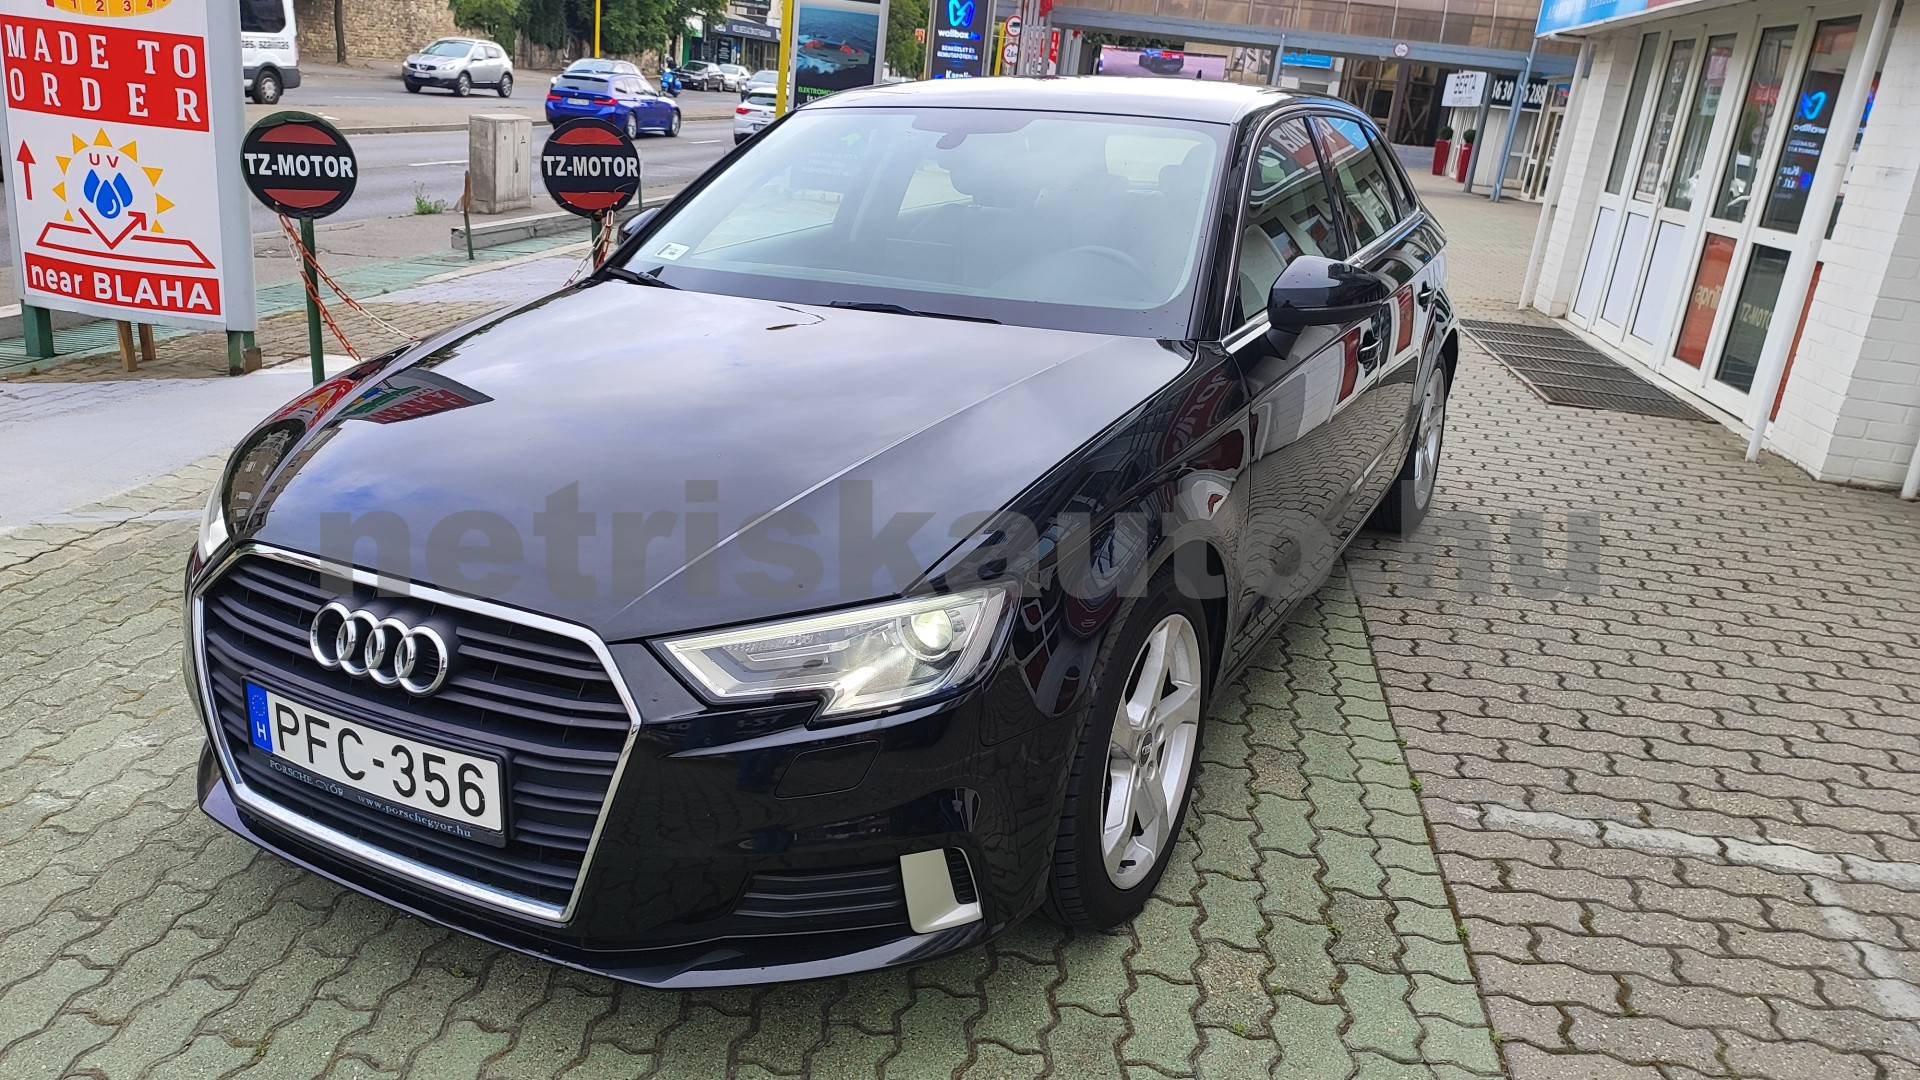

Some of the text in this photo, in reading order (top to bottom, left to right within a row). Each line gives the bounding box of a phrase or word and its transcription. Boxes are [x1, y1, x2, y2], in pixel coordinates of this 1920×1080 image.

[95, 0, 105, 11] 2
[123, 0, 132, 11] 3
[5, 24, 197, 79] MADE TO
[10, 67, 201, 123] ORDER
[88, 152, 119, 169] UV
[244, 152, 354, 179] TZ-MOTOR
[543, 154, 639, 178] TZ-MOTOR
[31, 263, 213, 311] near BLAHA
[256, 720, 267, 741] H
[275, 702, 486, 818] PFC-356
[269, 759, 313, 785] PORSCHE
[357, 794, 472, 838] www.porschegyor.hu
